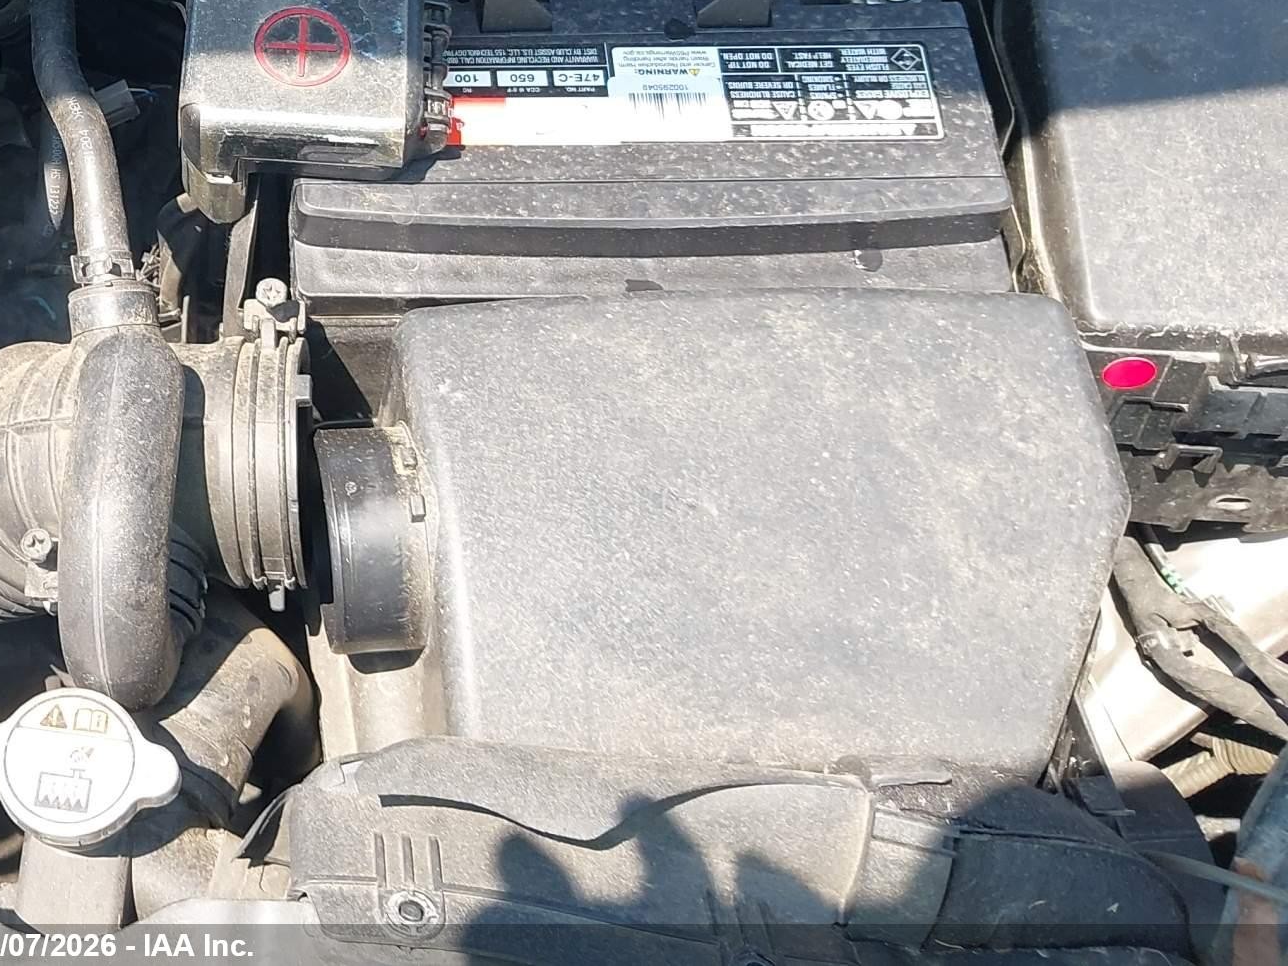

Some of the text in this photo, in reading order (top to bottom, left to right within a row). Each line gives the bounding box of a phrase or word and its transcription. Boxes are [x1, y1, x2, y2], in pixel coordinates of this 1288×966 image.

[476, 56, 516, 64] INFORMATION
[517, 56, 550, 64] RECYCLING
[744, 52, 760, 60] NOT
[762, 52, 774, 60] DO
[785, 60, 833, 68] GET MEDICAL
[455, 73, 600, 83] 47E-C 650 100
[753, 81, 782, 89] SEVERE
[782, 81, 794, 89] OR
[730, 90, 796, 98] CAUSE BLINDNESS
